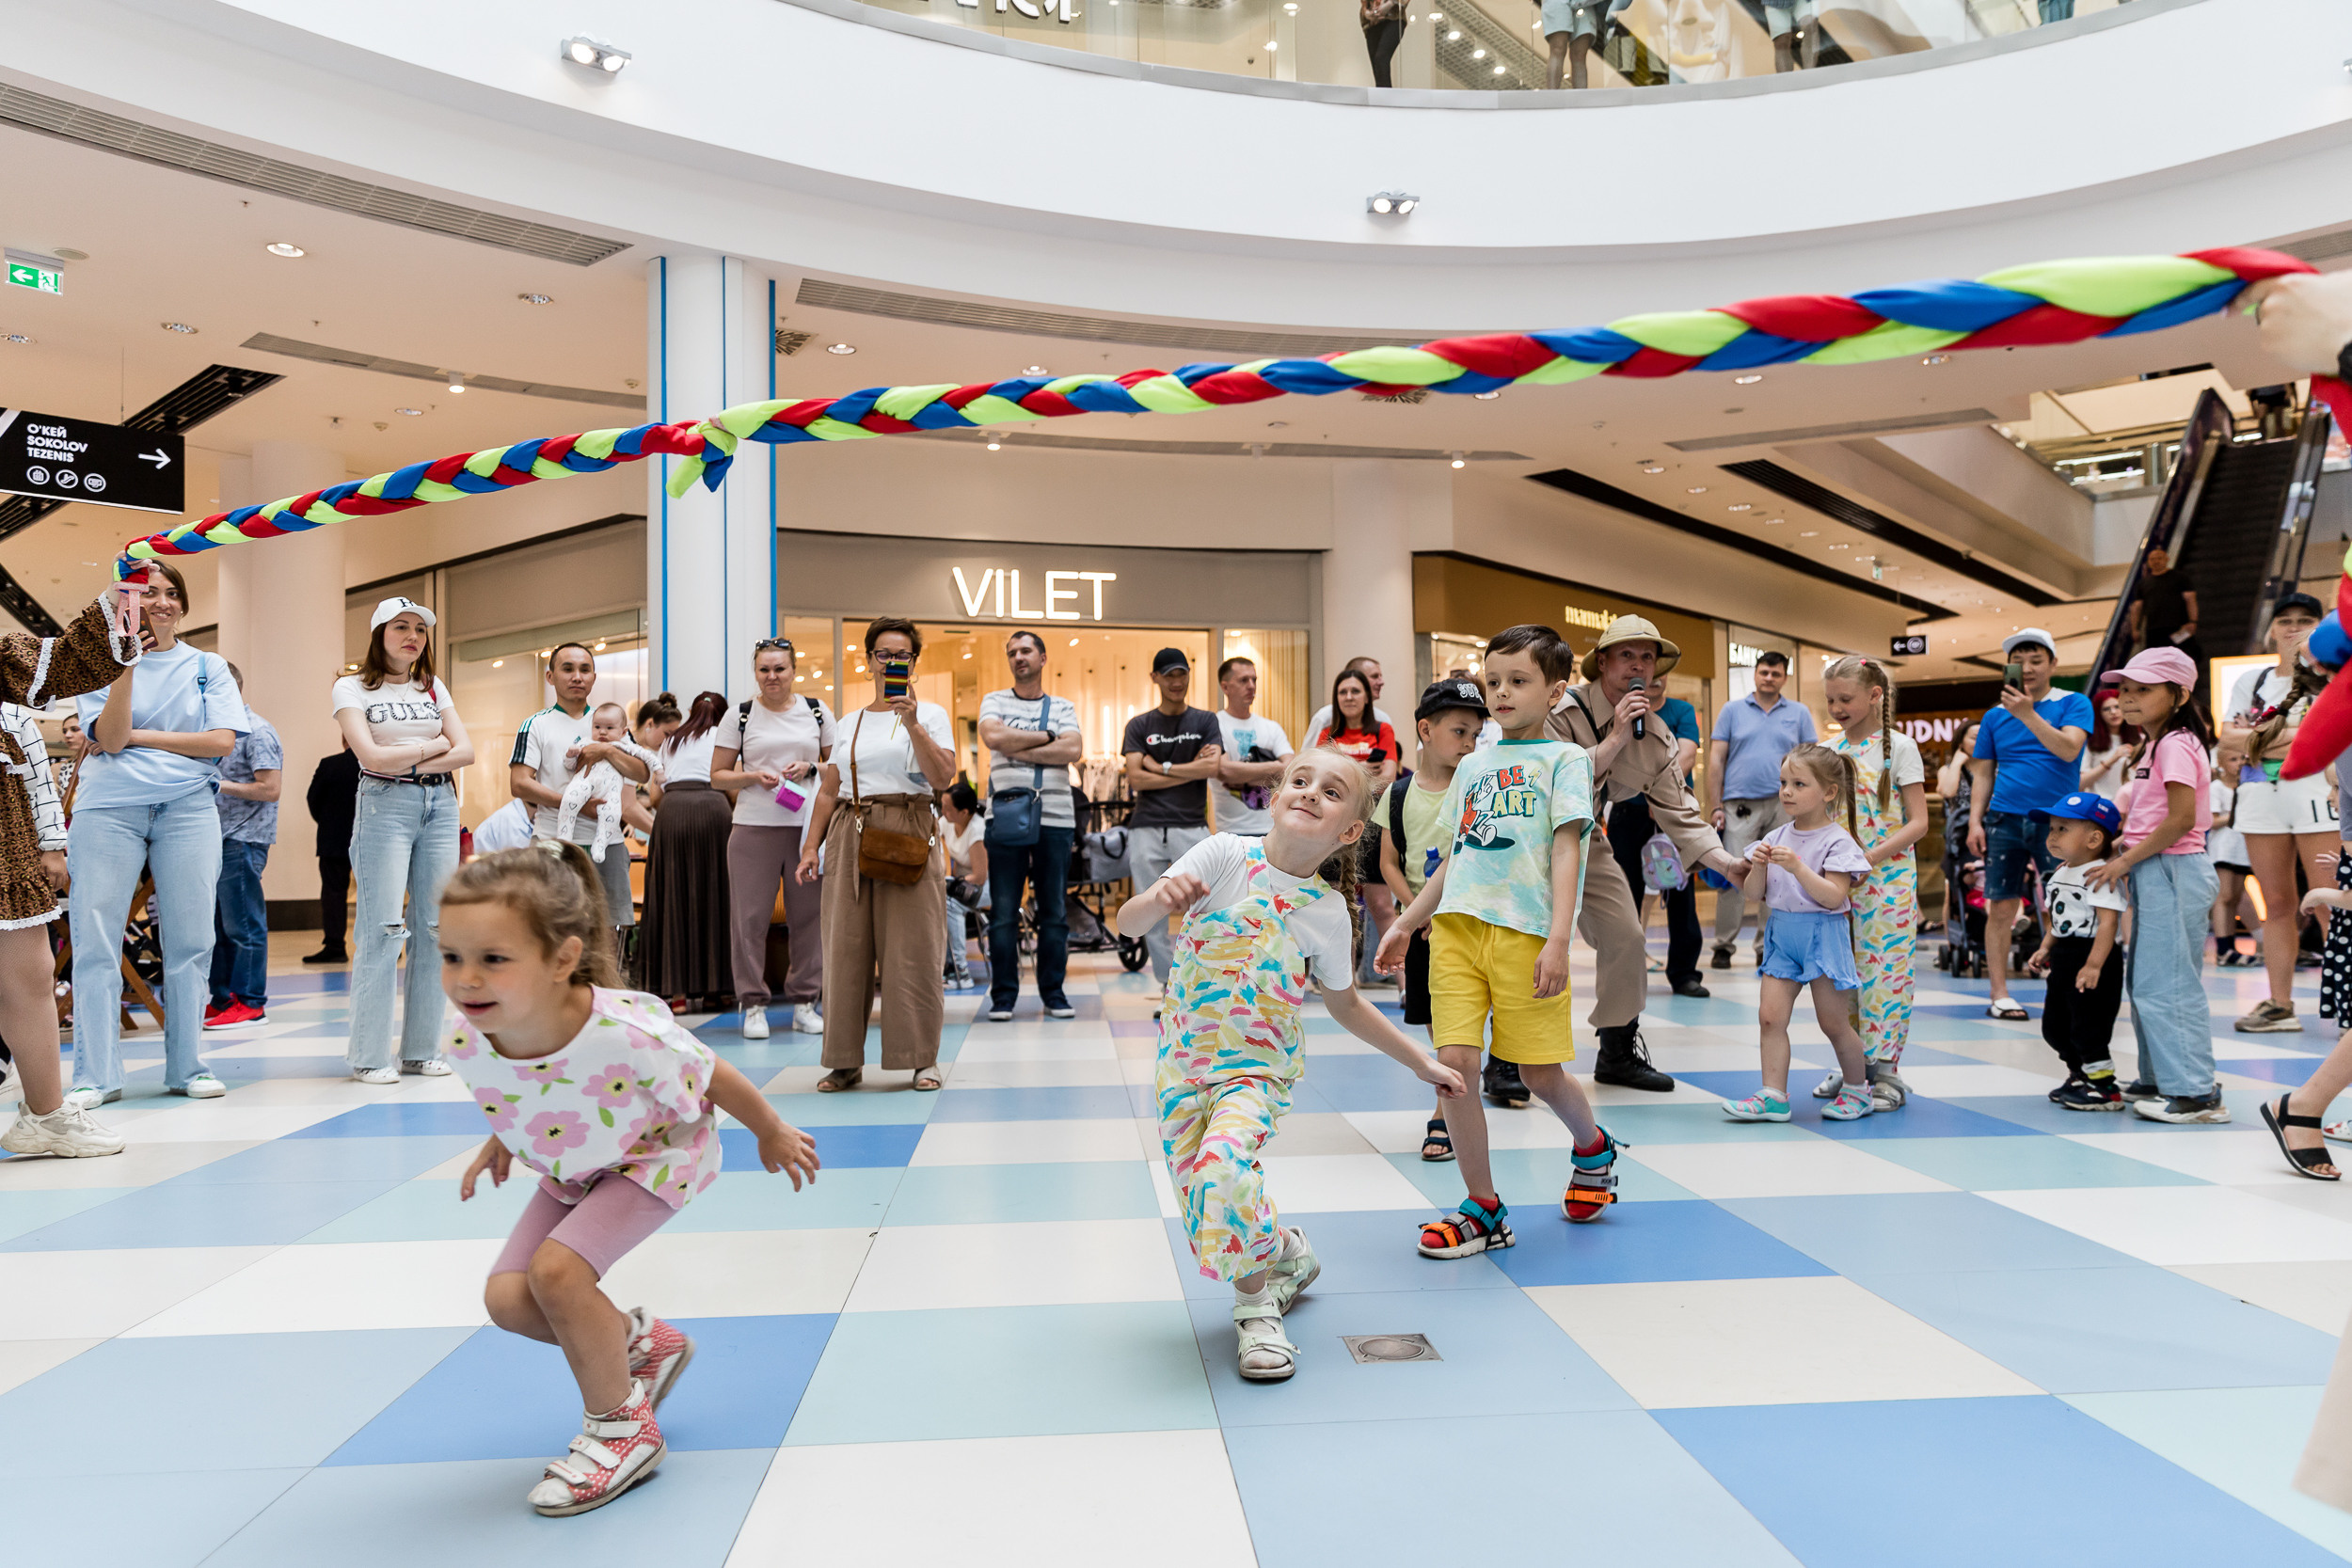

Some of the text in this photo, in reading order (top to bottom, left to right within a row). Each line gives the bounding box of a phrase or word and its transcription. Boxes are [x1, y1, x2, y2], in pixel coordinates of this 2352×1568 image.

[26, 423, 67, 438] О'КЕЙ
[26, 435, 88, 452] SOKOLOV
[26, 447, 74, 463] TEZENIS
[952, 566, 1117, 621] VILET
[366, 702, 443, 723] GUES
[1496, 765, 1526, 790] BE
[1491, 790, 1537, 818] ART
